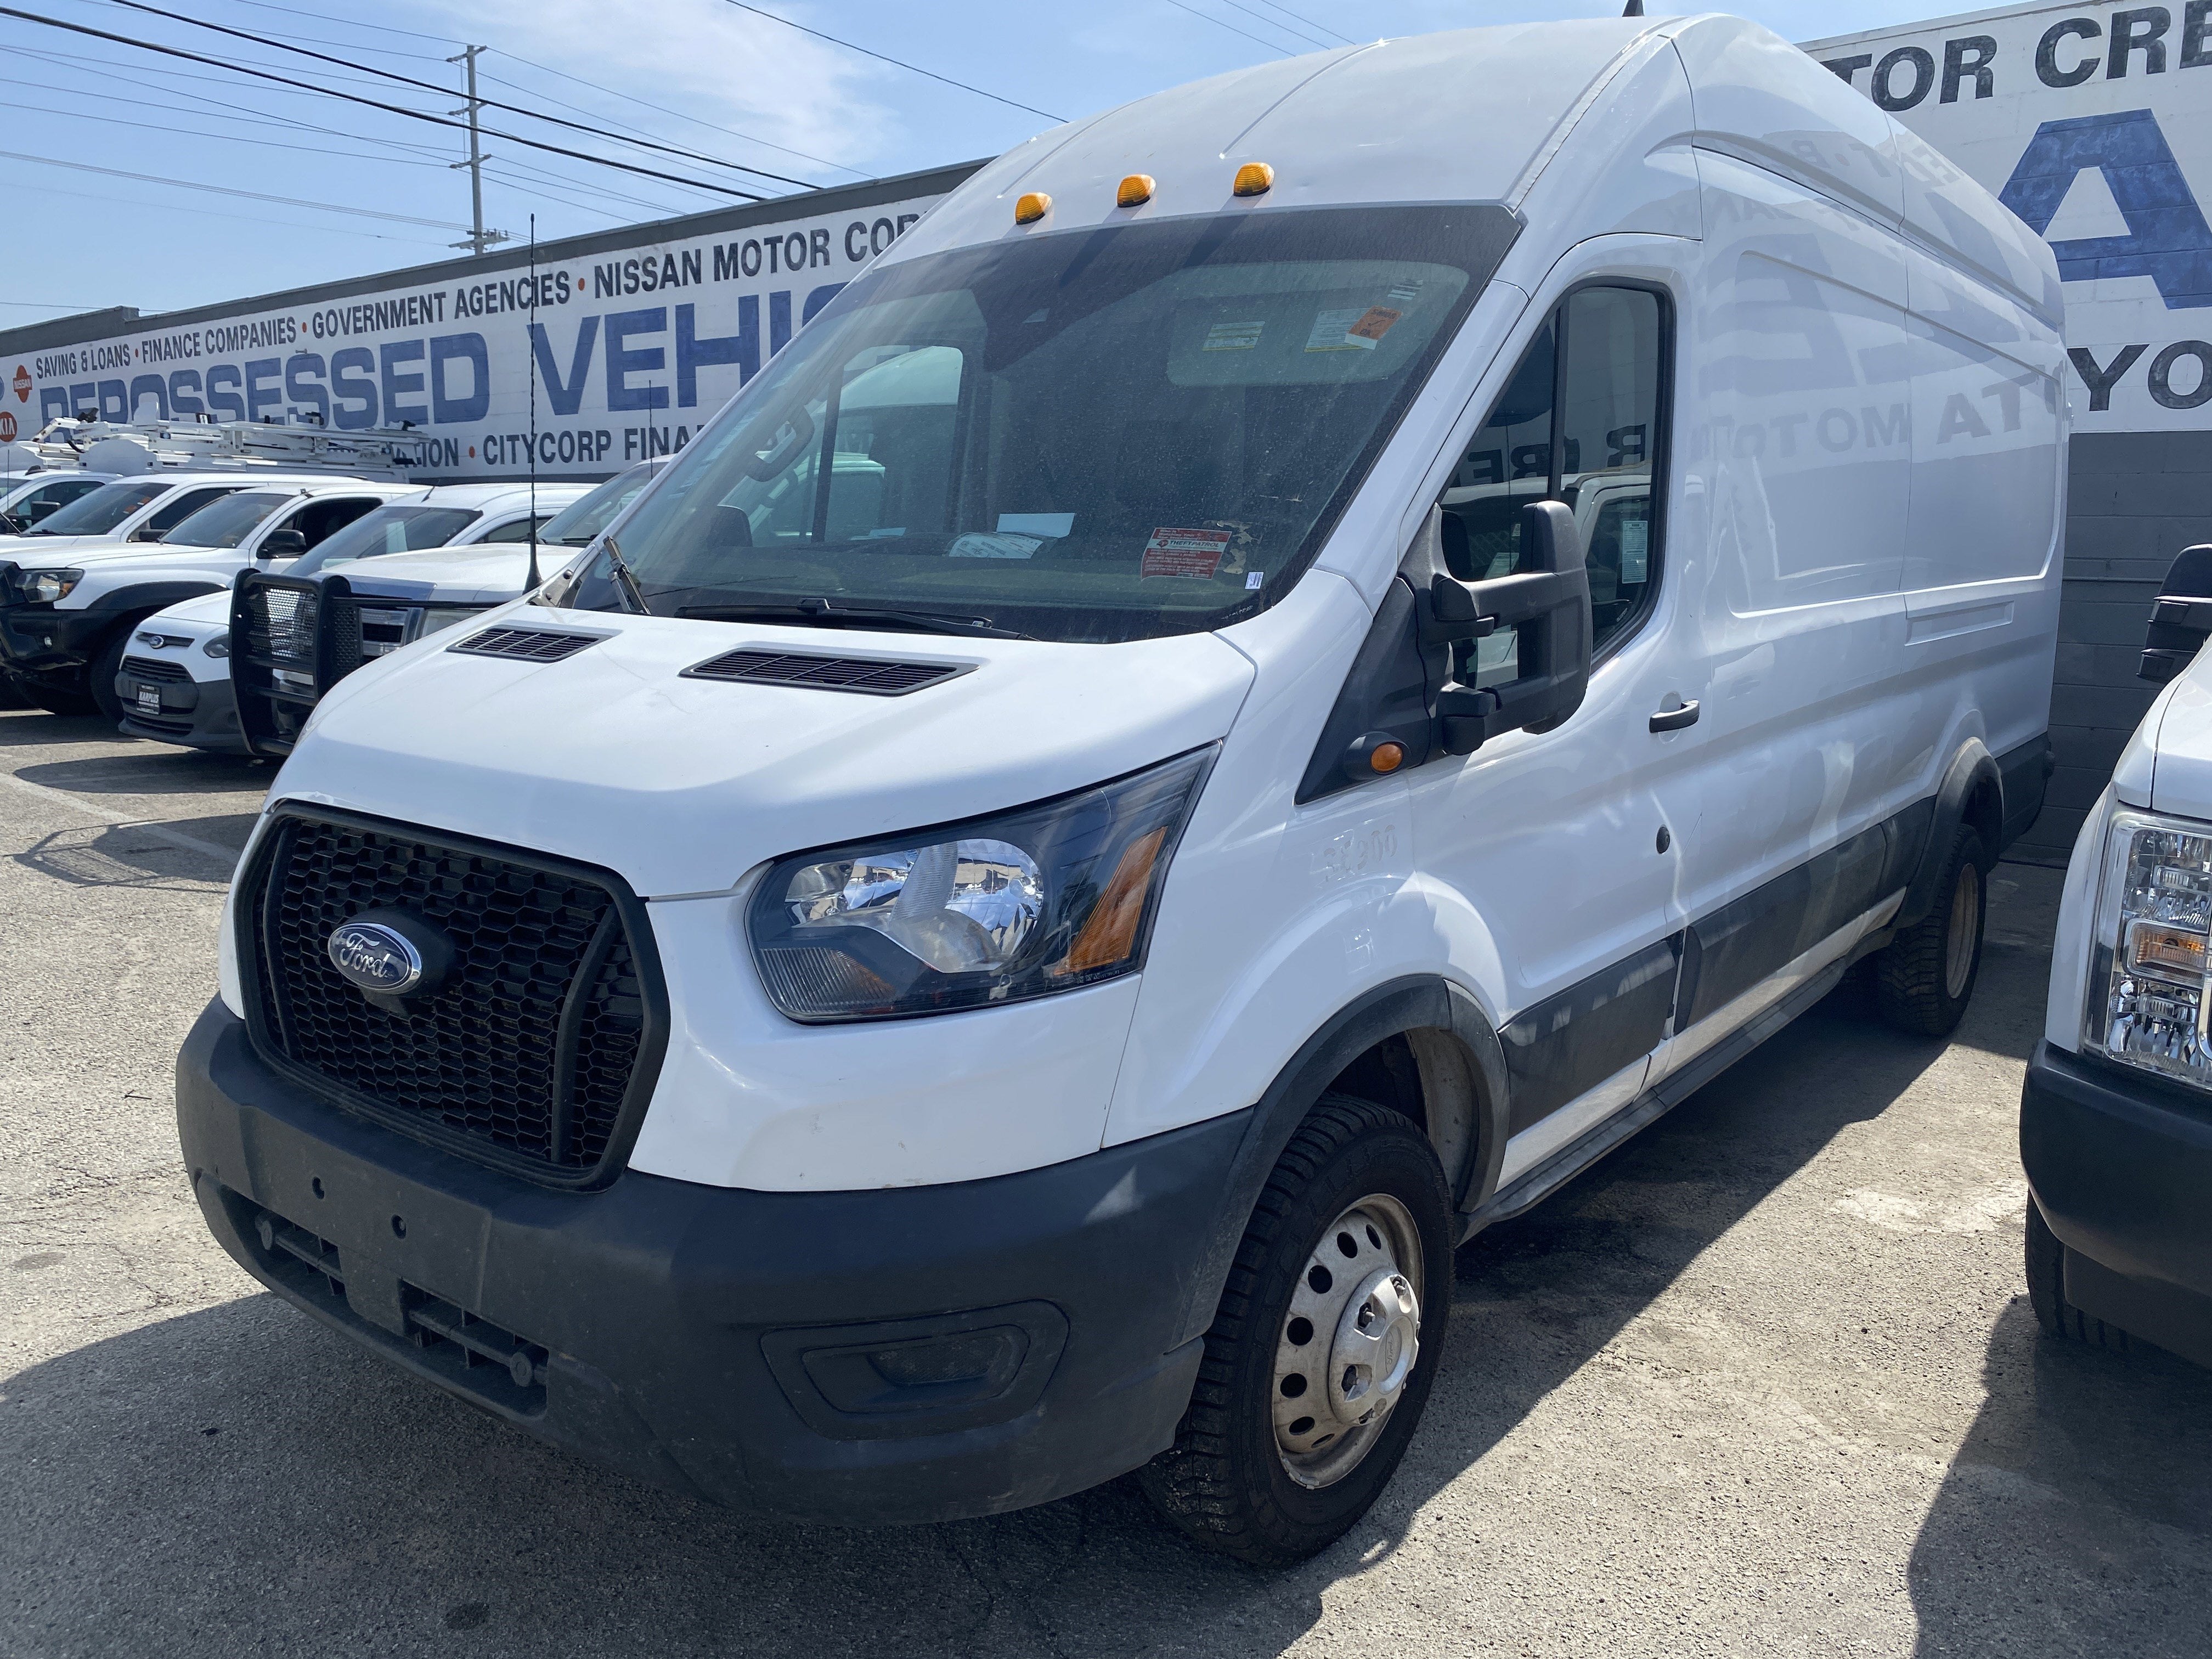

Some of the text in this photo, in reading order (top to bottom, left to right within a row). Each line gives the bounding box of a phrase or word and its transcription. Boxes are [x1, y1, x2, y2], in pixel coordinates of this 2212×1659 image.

[36, 352, 77, 379] SAVING
[81, 350, 88, 372] &
[91, 343, 131, 371] LOANS
[142, 332, 201, 364] FINANCE
[205, 316, 297, 354] COMPANIES
[313, 292, 447, 339] GOVERNMENT
[454, 270, 569, 319] AGENCIES
[594, 248, 702, 299] NISSAN
[714, 228, 831, 281] MOTOR
[40, 332, 490, 443] REPOSSESSED
[2067, 340, 2212, 412] YO
[483, 430, 612, 465] CITYCORP
[624, 425, 706, 460] FINA
[339, 932, 391, 978] Ford
